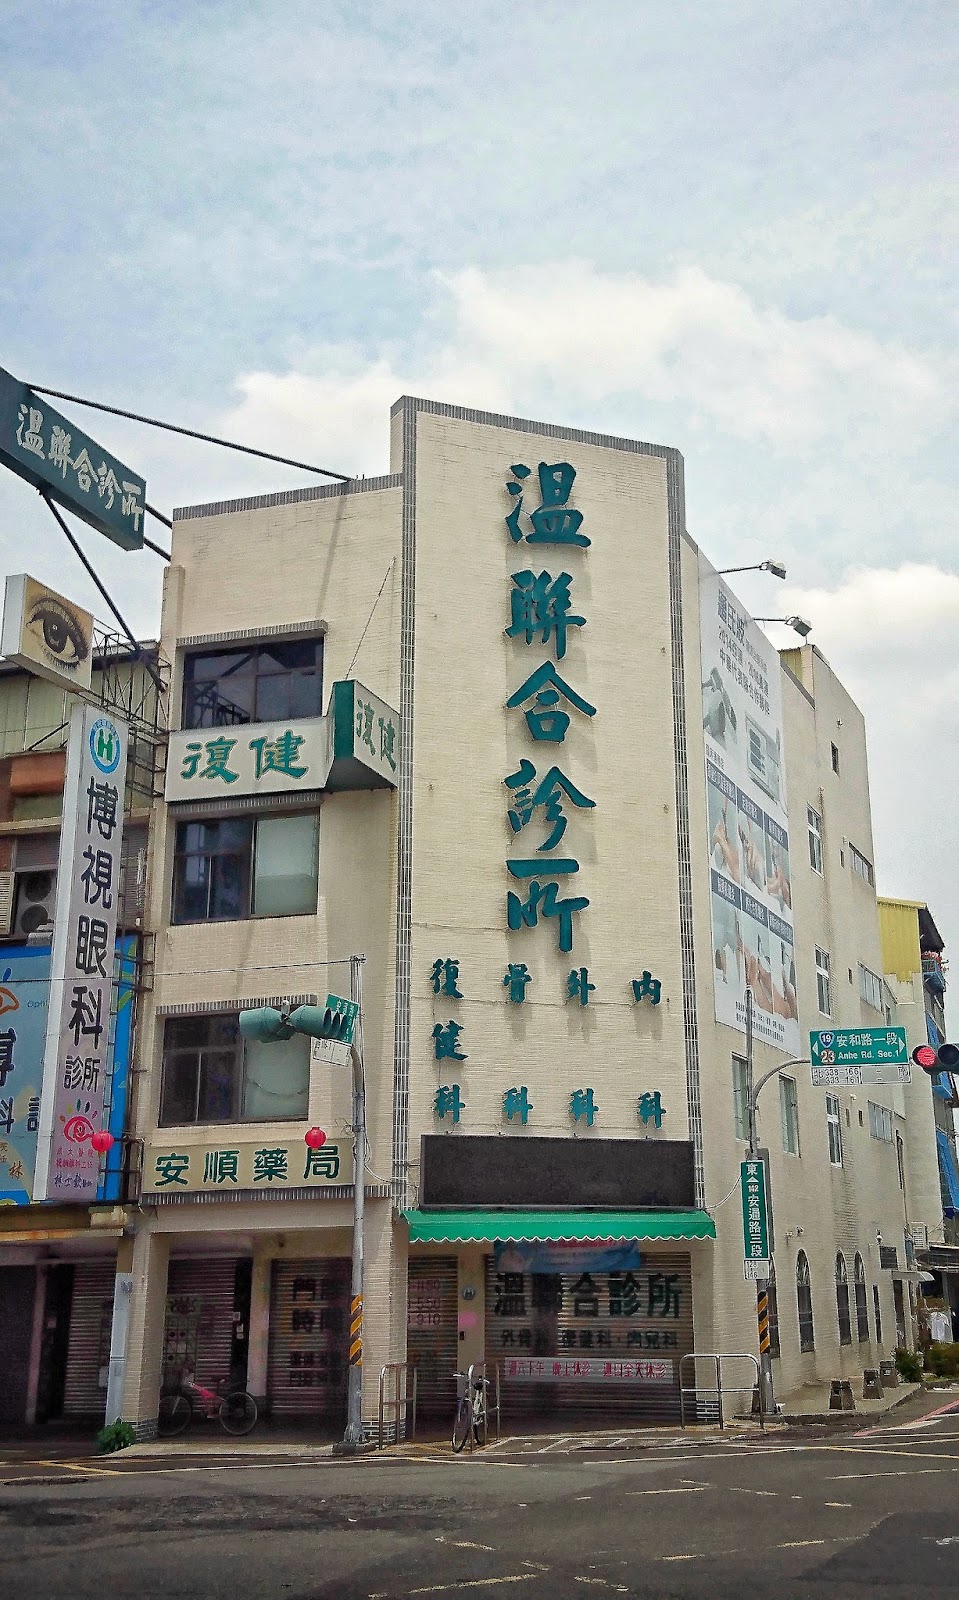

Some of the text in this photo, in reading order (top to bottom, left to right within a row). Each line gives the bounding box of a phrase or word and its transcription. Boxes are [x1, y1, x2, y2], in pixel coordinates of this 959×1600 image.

[15, 404, 143, 531] 溫聯合診所
[505, 462, 598, 952] 溫聯合診所
[180, 728, 309, 785] 復健
[68, 775, 119, 1049] 博視眼科
[820, 1050, 836, 1064] 23
[838, 1052, 859, 1060] Anhe
[861, 1050, 875, 1059] Rd.
[821, 1032, 899, 1047] 19 安和路一段
[63, 1055, 101, 1093] 診所
[154, 1146, 341, 1187] 安順藥局
[746, 1163, 758, 1175] 東
[747, 1194, 763, 1257] 安通路三段
